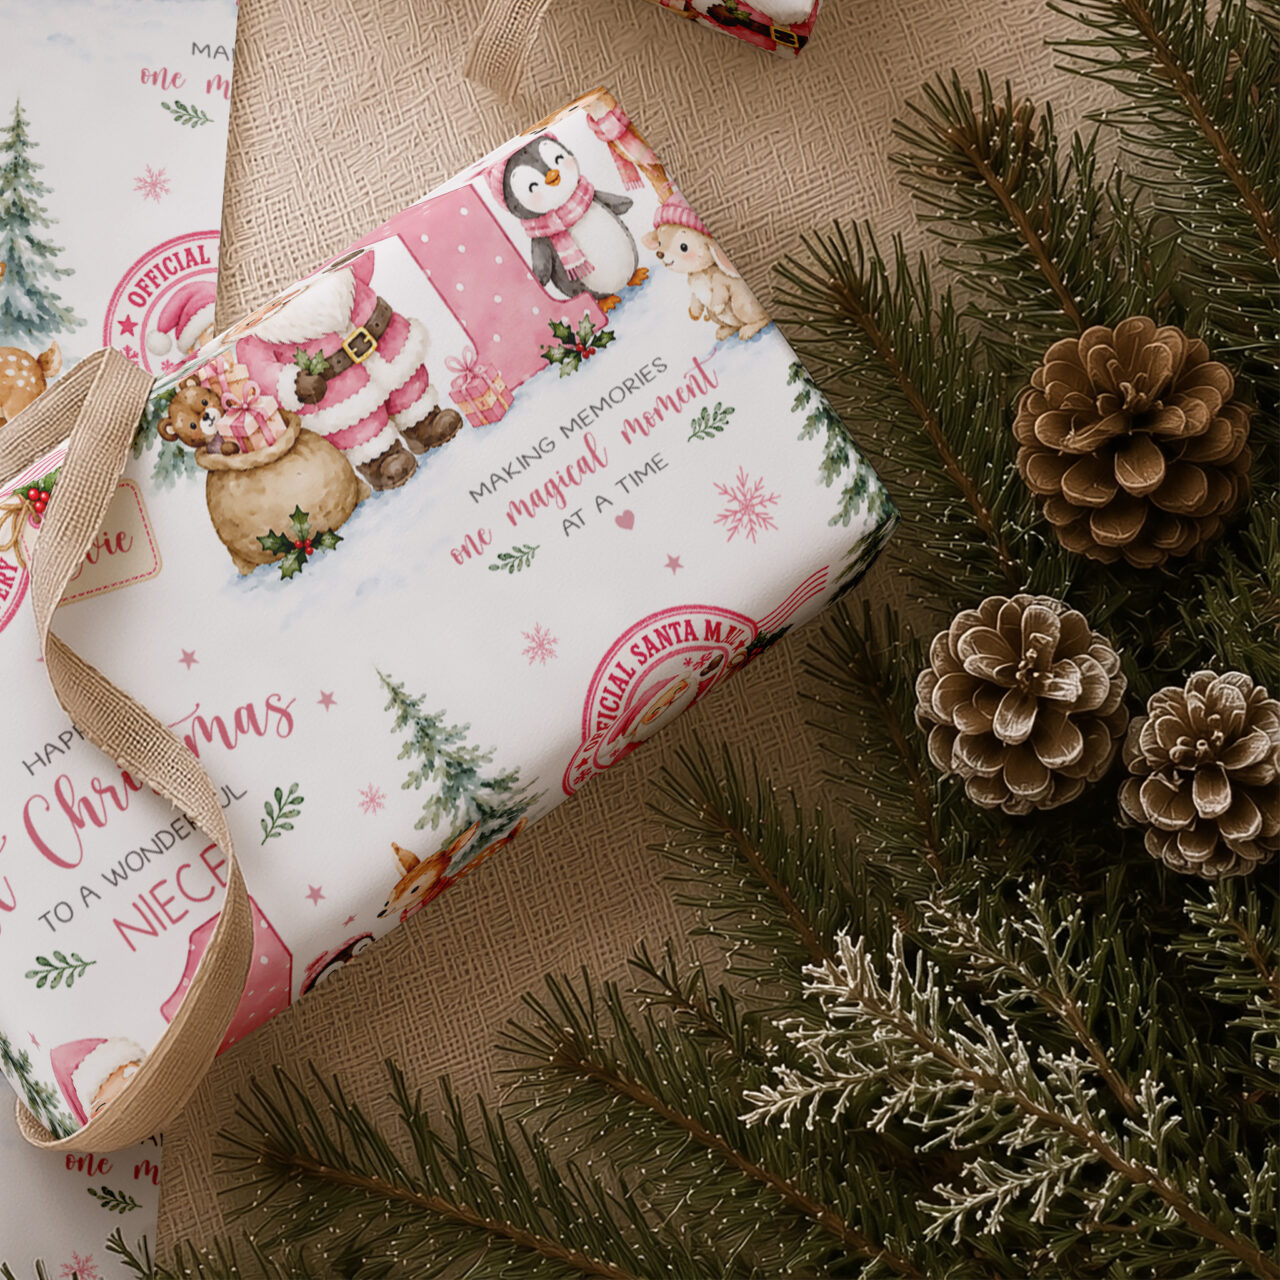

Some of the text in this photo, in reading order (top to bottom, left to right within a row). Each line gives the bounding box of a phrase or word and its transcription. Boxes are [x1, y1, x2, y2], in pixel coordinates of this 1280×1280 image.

[140, 67, 187, 92] one
[128, 244, 211, 308] OFFICIAL
[450, 347, 719, 566] one magical moment
[468, 356, 668, 504] MAKING MEMORIES
[562, 452, 670, 538] AT A TIME
[630, 618, 699, 666] SANTA
[22, 725, 85, 776] HAP
[22, 694, 297, 870] Chrimas
[38, 900, 74, 933] TO
[79, 883, 102, 909] A
[112, 843, 226, 952] NIECE
[66, 1152, 114, 1177] one
